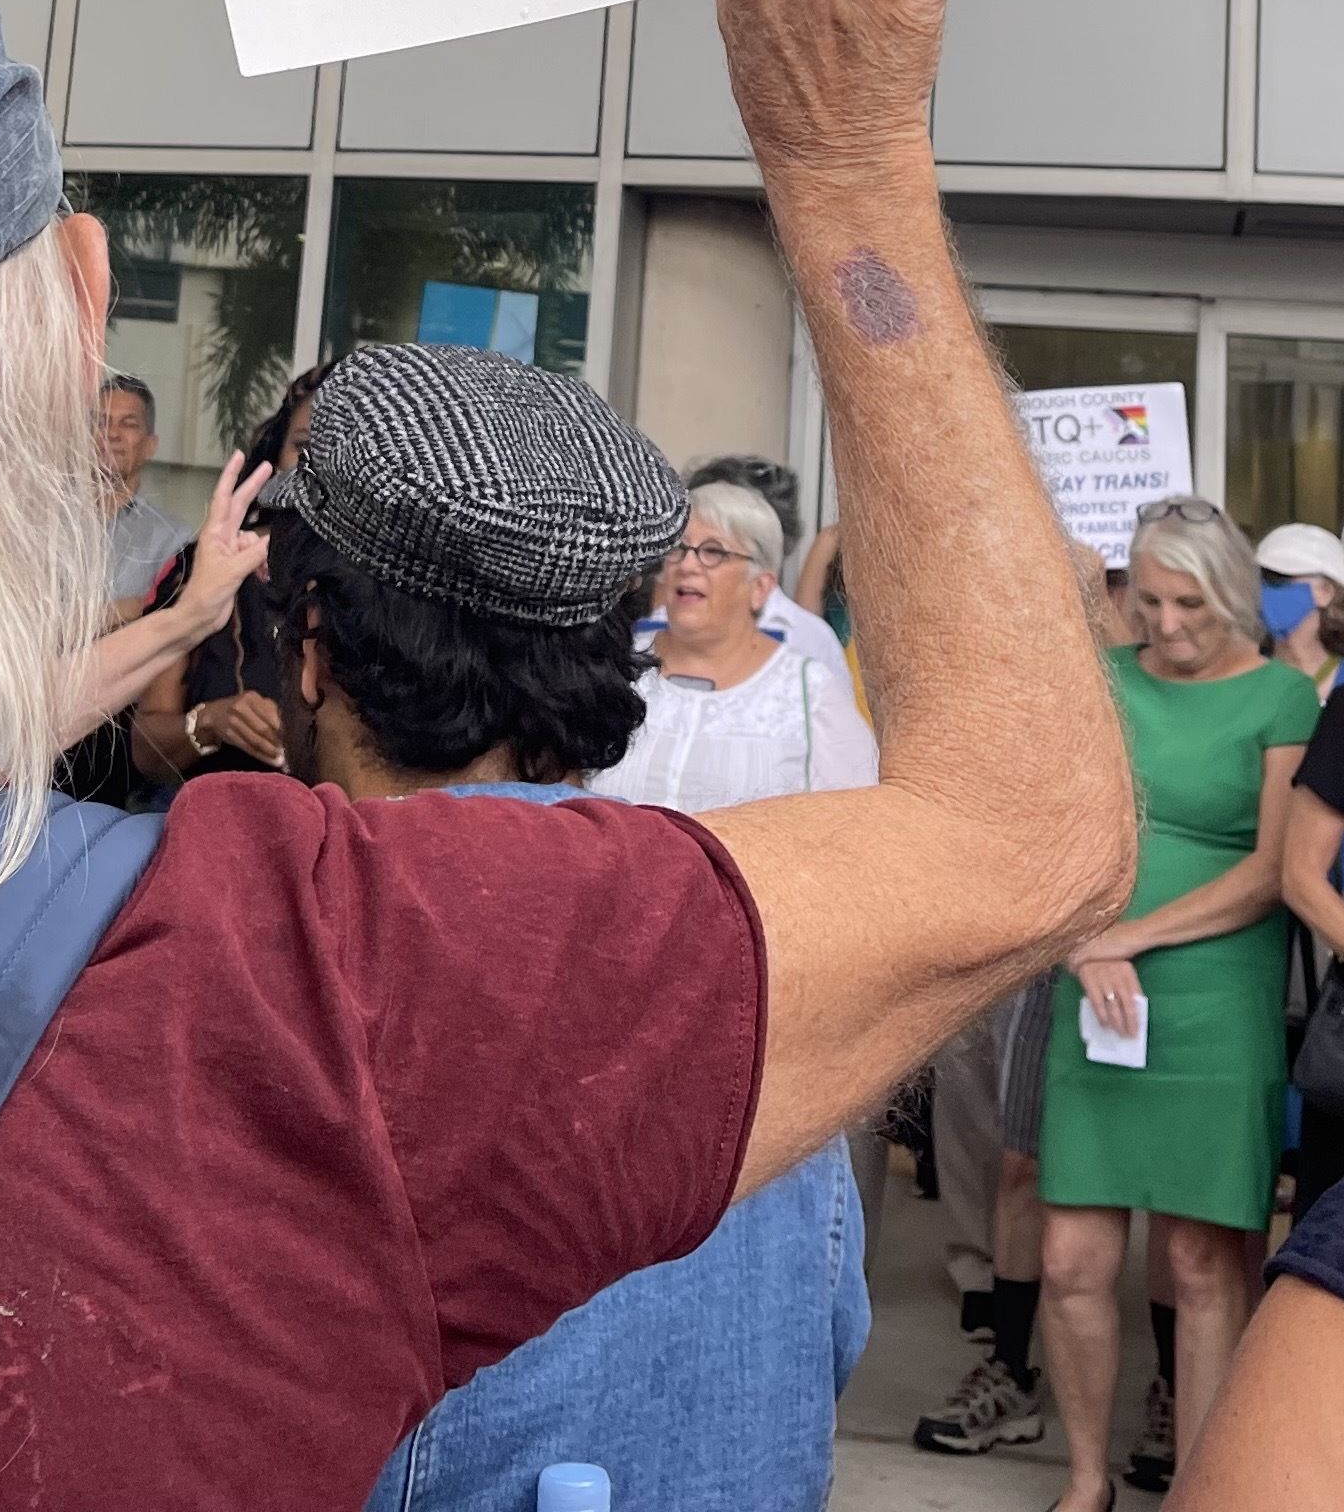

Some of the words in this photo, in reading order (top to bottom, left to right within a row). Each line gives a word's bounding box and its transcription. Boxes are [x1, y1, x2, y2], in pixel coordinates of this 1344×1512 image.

[1080, 391, 1146, 406] COUNTY
[1079, 449, 1150, 464] CAUCUS
[1094, 471, 1168, 490] TRANS!
